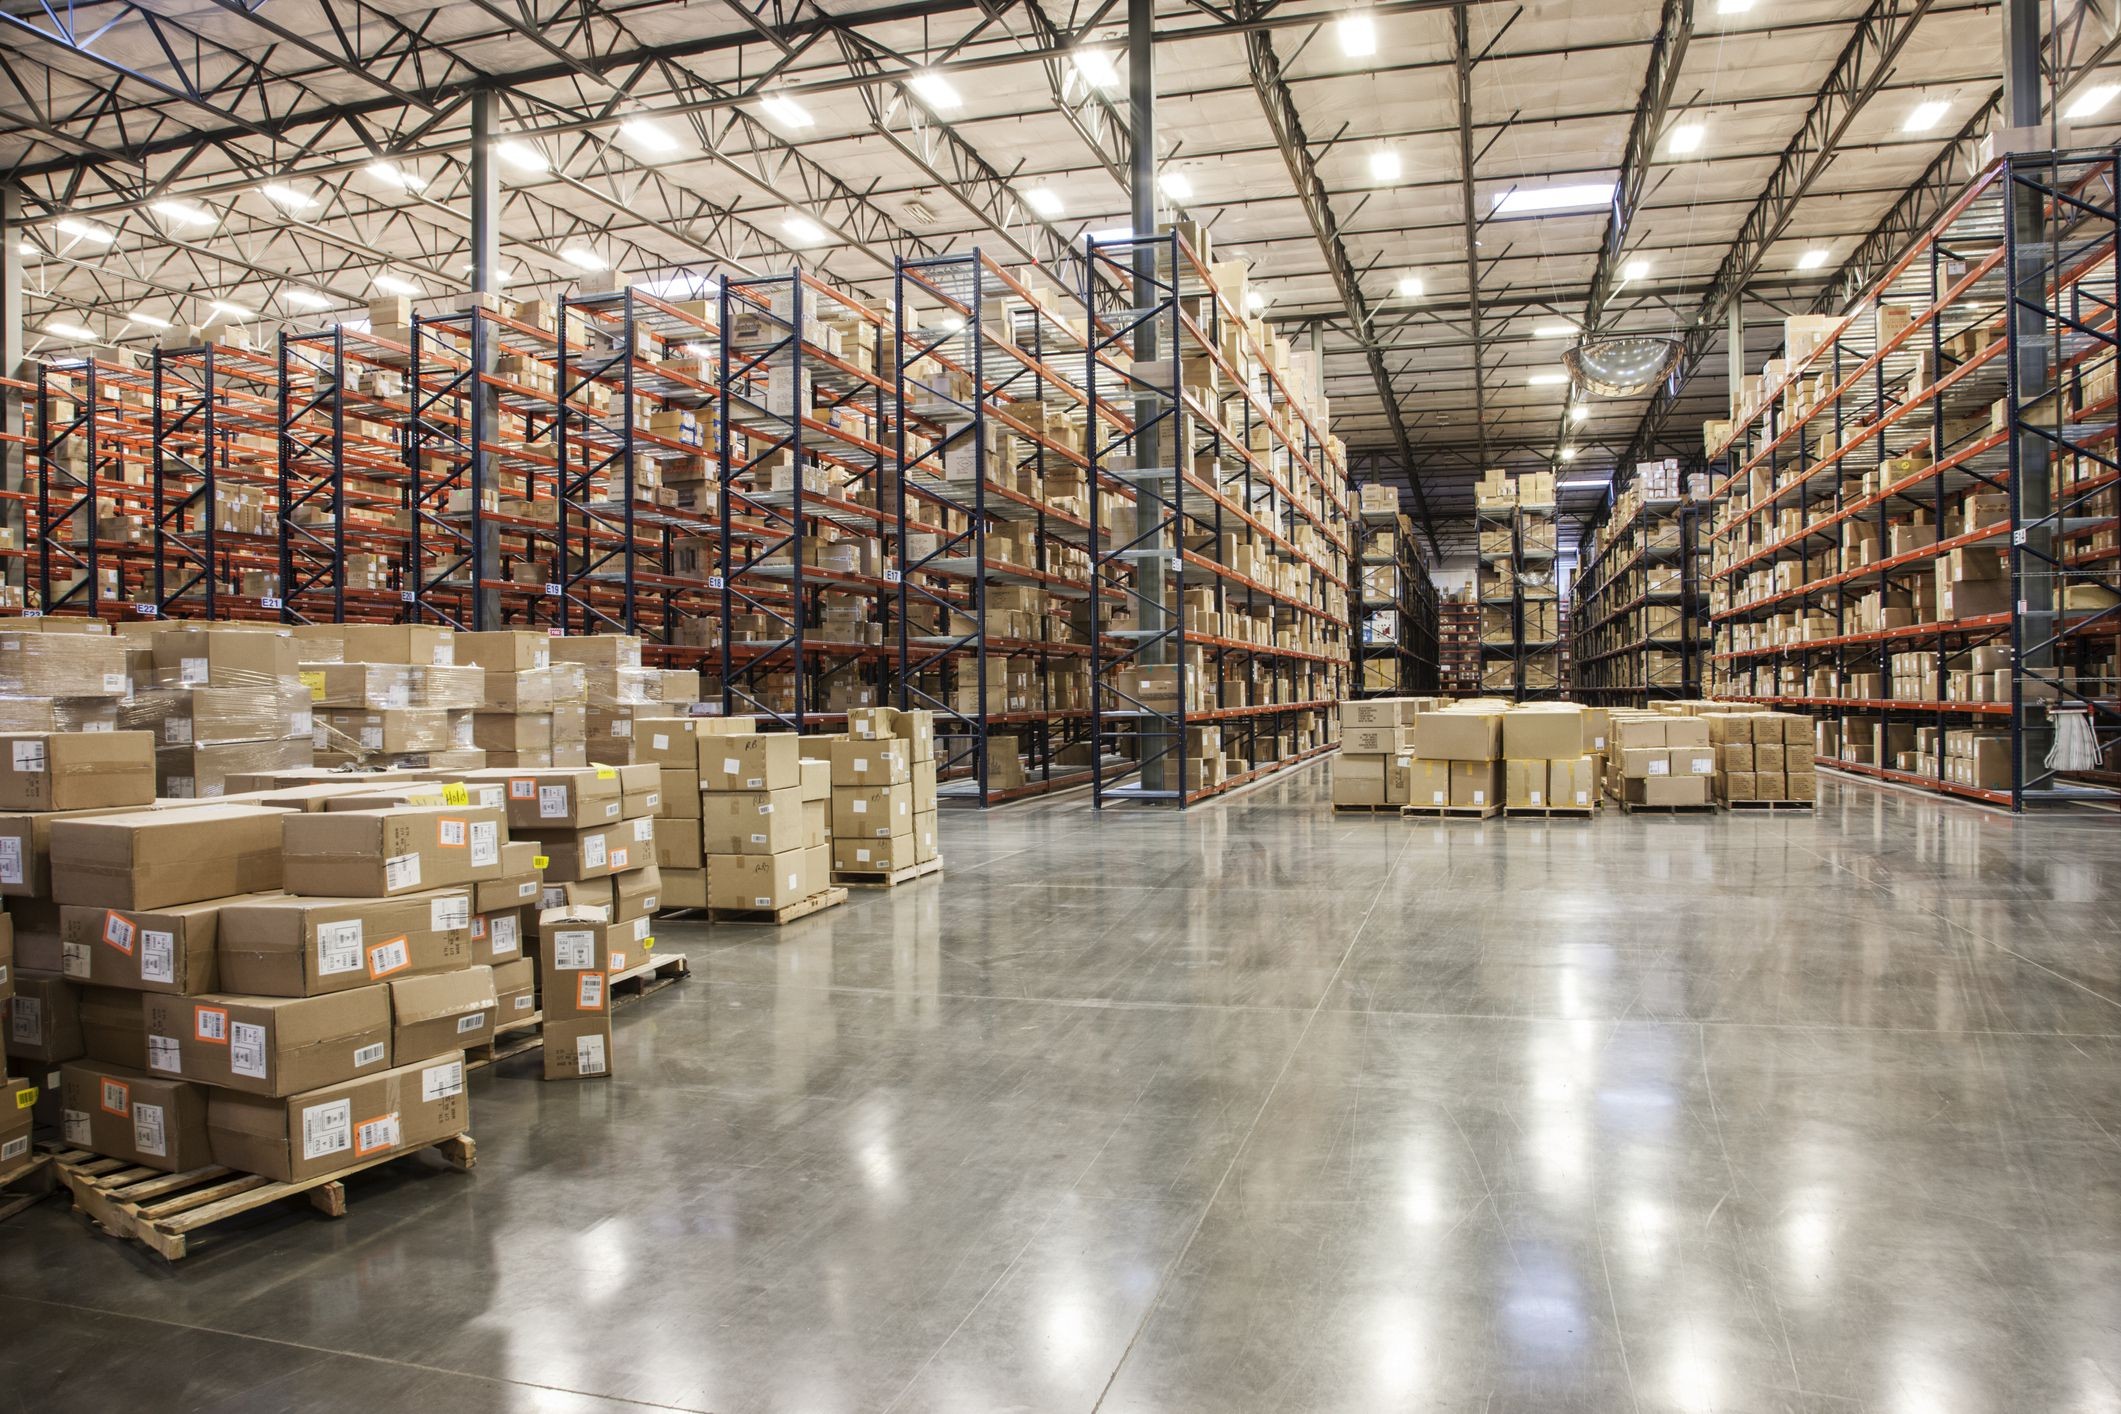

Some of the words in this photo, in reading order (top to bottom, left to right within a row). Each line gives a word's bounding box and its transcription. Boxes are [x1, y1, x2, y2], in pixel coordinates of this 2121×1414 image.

[887, 570, 899, 581] E17
[709, 577, 721, 588] E18
[547, 584, 559, 594] E19
[262, 598, 279, 608] E21
[138, 604, 155, 613] E22
[446, 788, 466, 806] Hold
